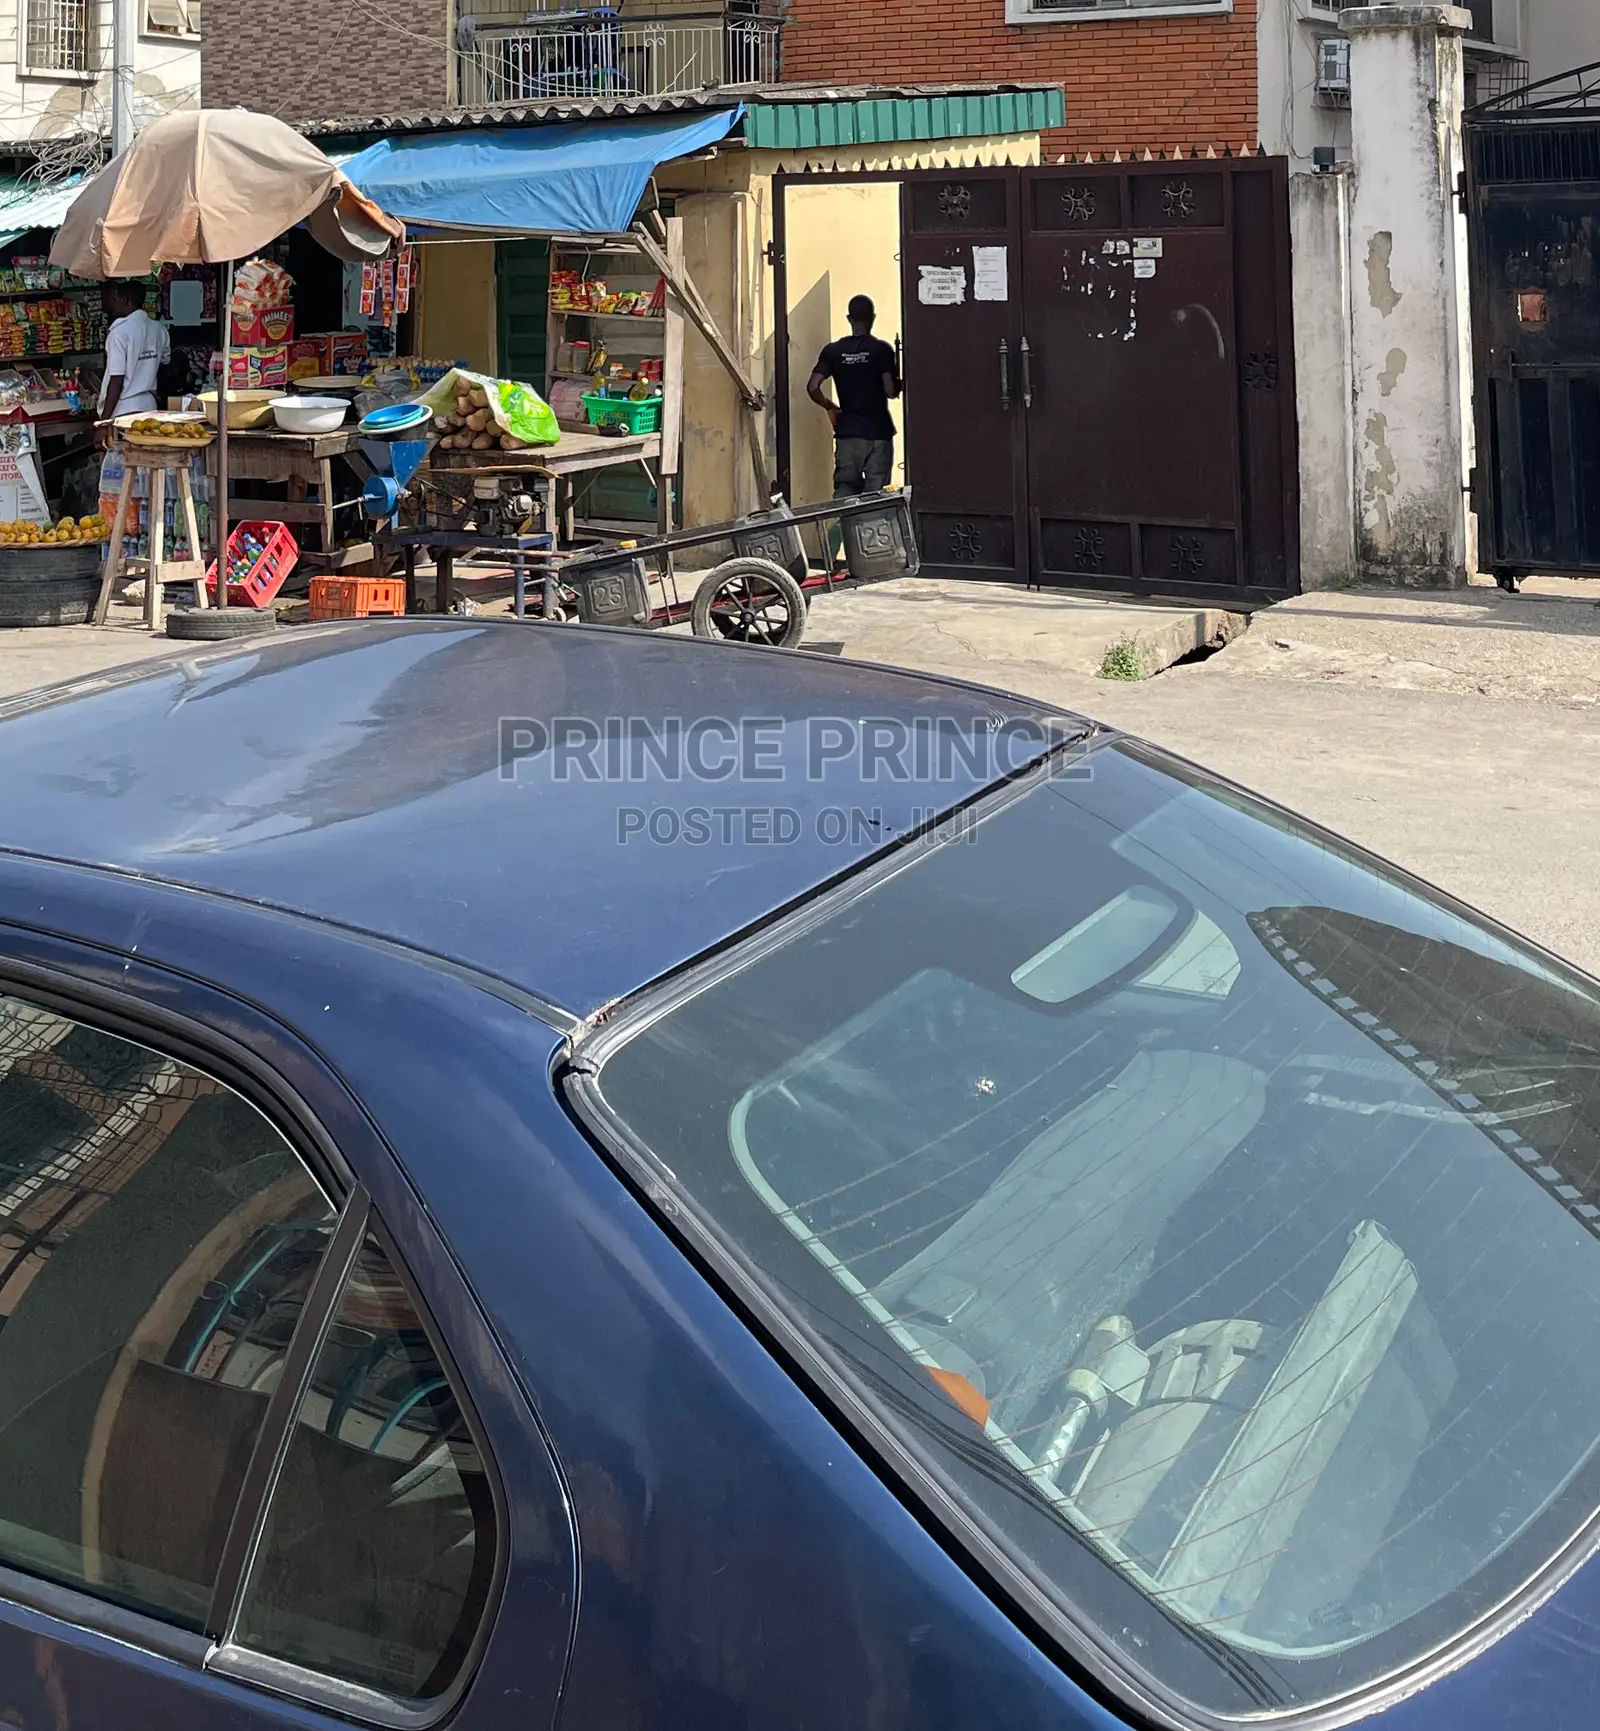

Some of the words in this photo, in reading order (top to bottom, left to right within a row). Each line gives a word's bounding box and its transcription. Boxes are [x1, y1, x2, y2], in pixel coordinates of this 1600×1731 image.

[0, 472, 24, 480] STOR
[861, 523, 890, 550] 25
[593, 582, 621, 610] 25
